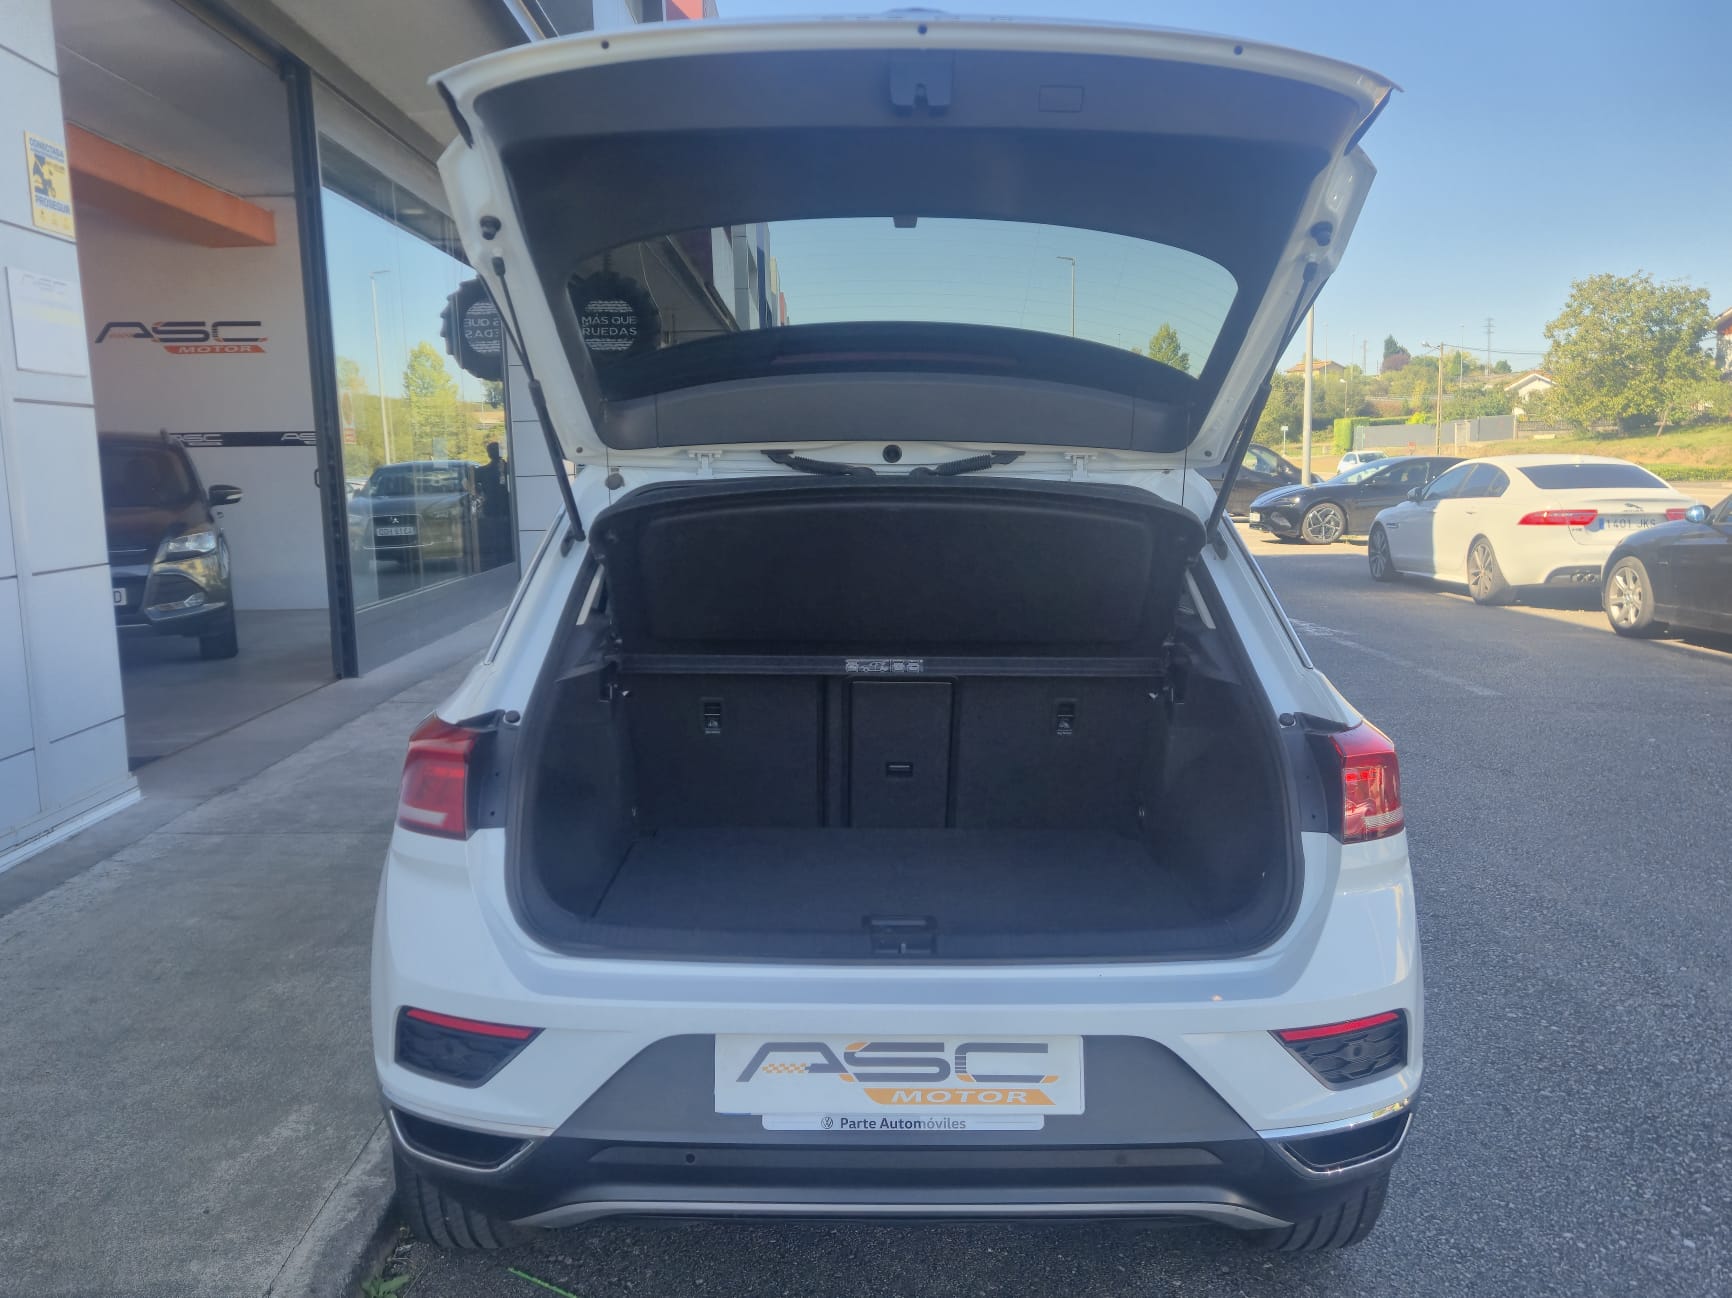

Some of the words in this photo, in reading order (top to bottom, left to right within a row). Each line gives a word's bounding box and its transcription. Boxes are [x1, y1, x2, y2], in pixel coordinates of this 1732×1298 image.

[582, 313, 608, 325] MÁS
[612, 316, 637, 325] QUE
[94, 321, 268, 343] ASC
[582, 327, 637, 336] RUEDAS
[178, 345, 253, 353] MOTOR
[281, 432, 316, 440] AS
[736, 1042, 1060, 1083] ASC
[890, 1089, 1027, 1104] MOTOR
[840, 1117, 877, 1129] Parte
[880, 1117, 967, 1129] Automóviles
